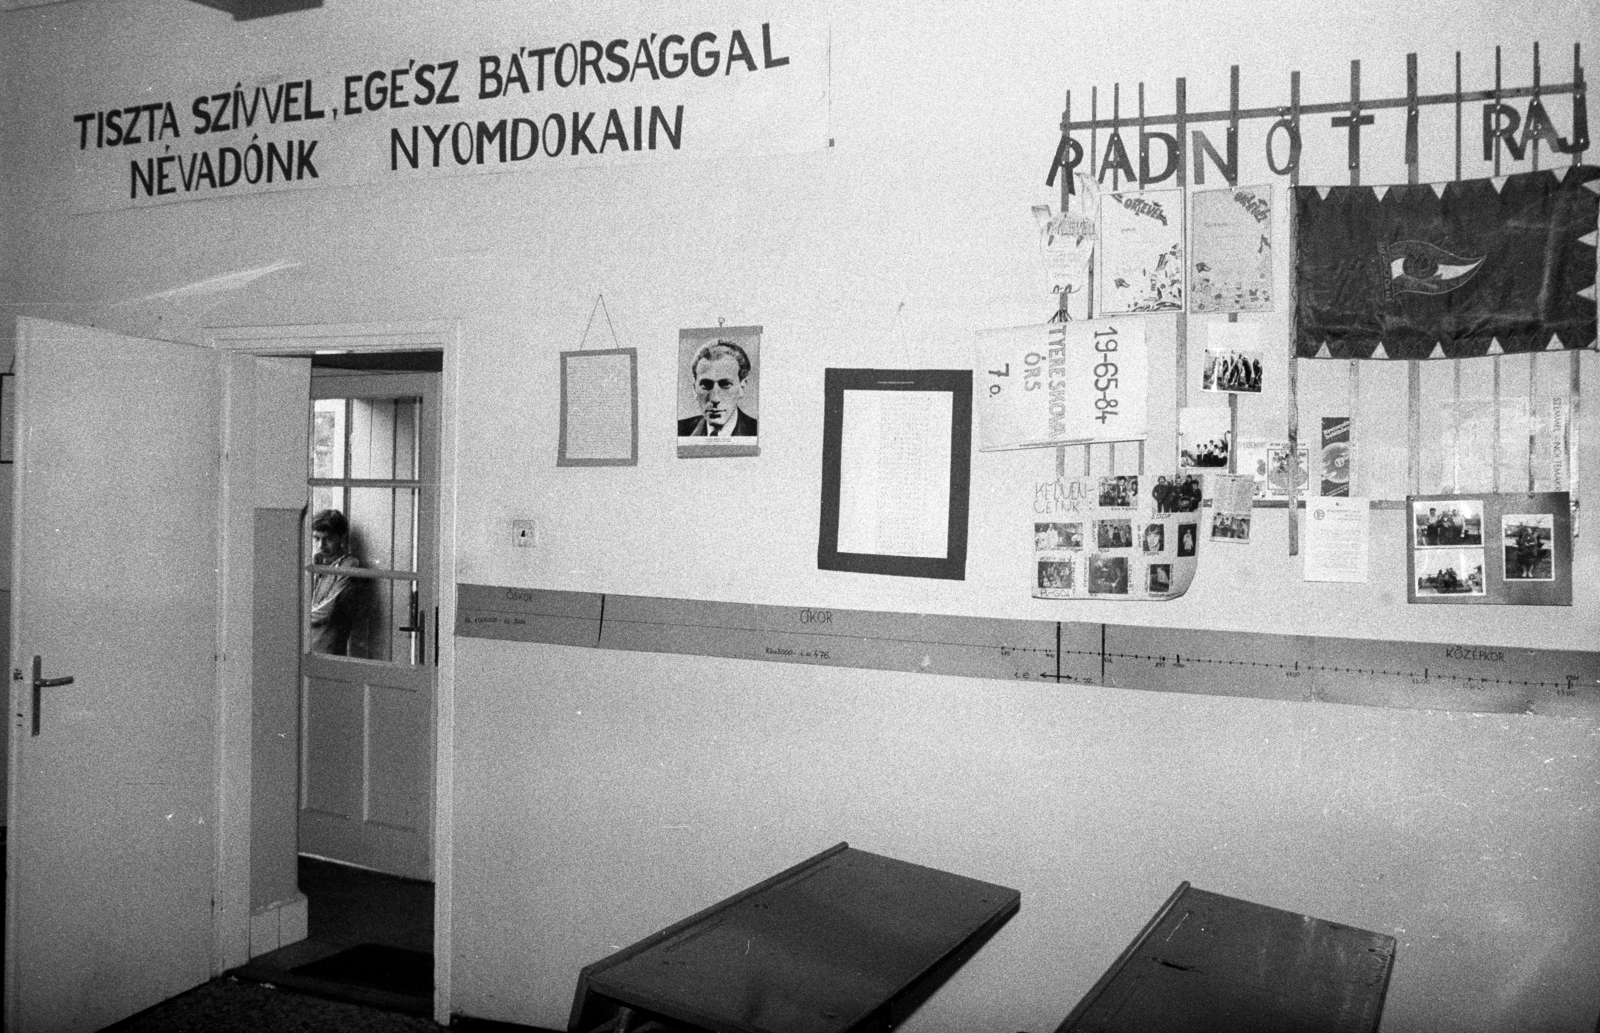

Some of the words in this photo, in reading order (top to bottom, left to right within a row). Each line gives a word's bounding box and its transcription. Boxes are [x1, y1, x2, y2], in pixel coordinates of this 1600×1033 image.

[74, 101, 180, 150] TISZTA
[344, 59, 459, 115] EGÉSZ
[478, 23, 790, 99] BÁTORSÁGGAL
[1483, 90, 1590, 160] RAJ
[130, 133, 319, 198] NÉVADÓNK
[391, 105, 684, 170] NYOMDOKAIN
[1093, 326, 1118, 424] 19-65-84
[800, 608, 832, 624] ÓKOR
[1446, 646, 1505, 662] KÖZÉPKOR
